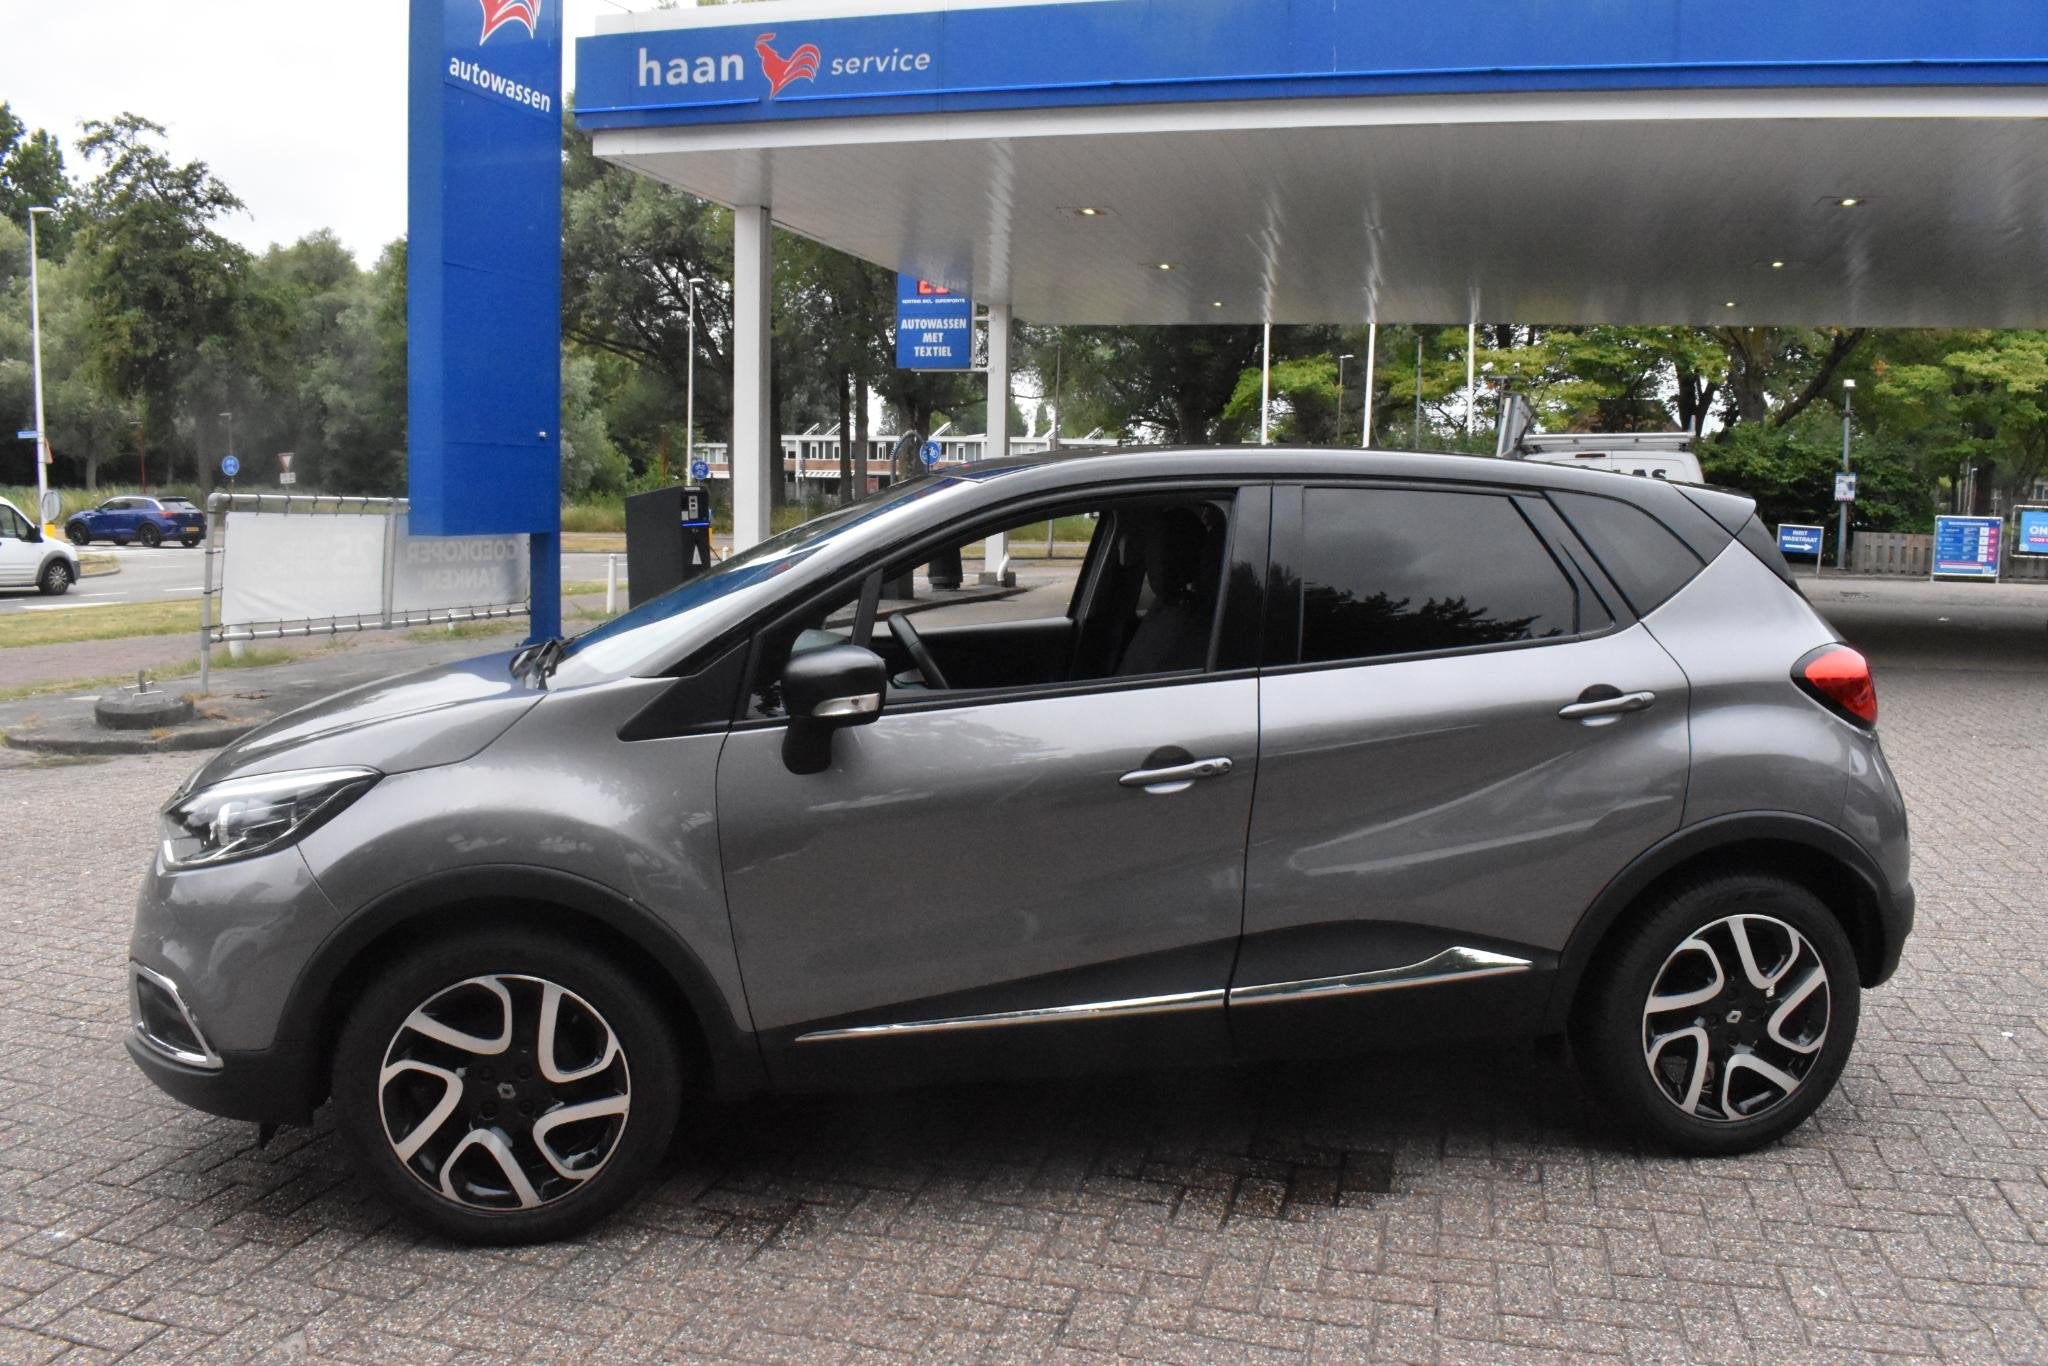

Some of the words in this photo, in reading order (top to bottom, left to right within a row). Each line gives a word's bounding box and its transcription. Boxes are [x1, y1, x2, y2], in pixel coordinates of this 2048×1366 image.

[638, 47, 744, 87] haan
[831, 48, 931, 76] service
[449, 57, 551, 113] autowassen
[901, 318, 967, 330] AUTOWASSEN
[922, 332, 944, 343] MET
[914, 346, 952, 357] TEXTIEL
